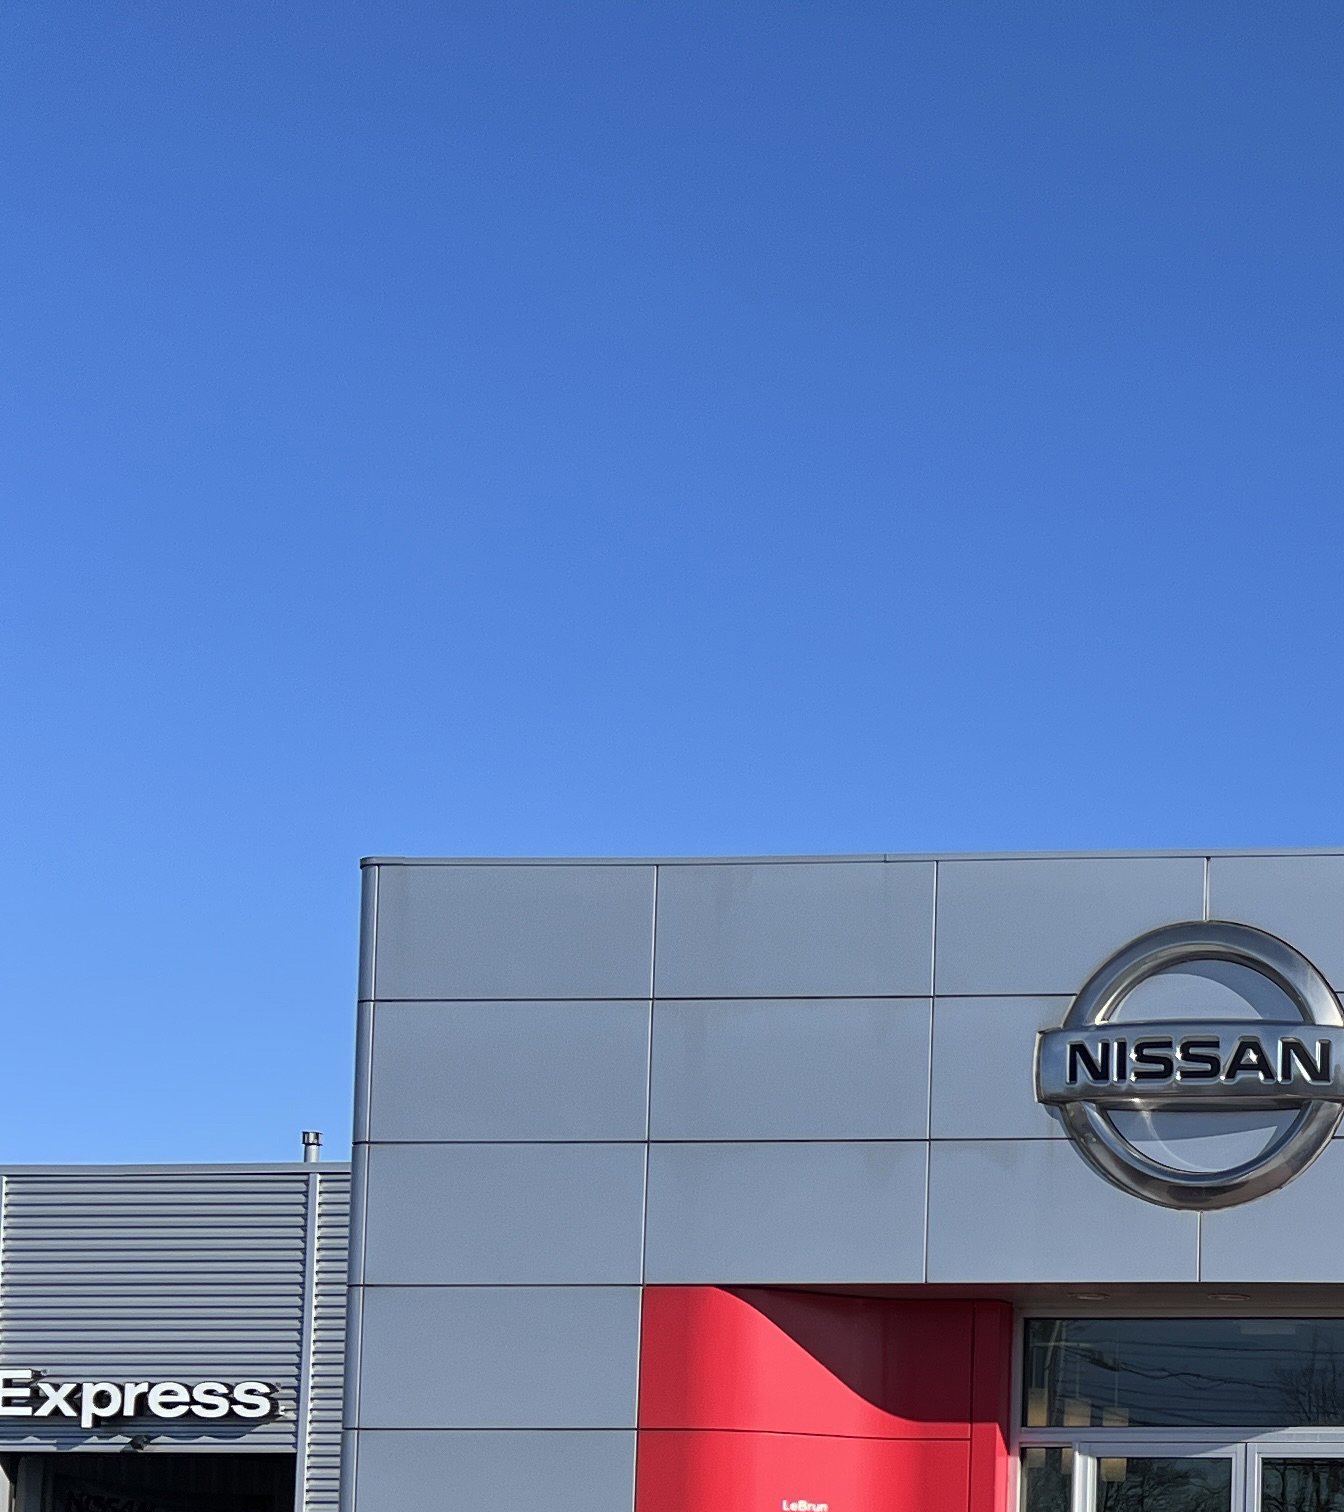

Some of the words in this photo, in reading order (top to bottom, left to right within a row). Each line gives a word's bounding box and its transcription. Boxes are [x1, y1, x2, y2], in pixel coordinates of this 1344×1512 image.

[1065, 1037, 1333, 1085] NISSAN
[0, 1368, 271, 1429] Express
[782, 1499, 829, 1512] LeBrun
